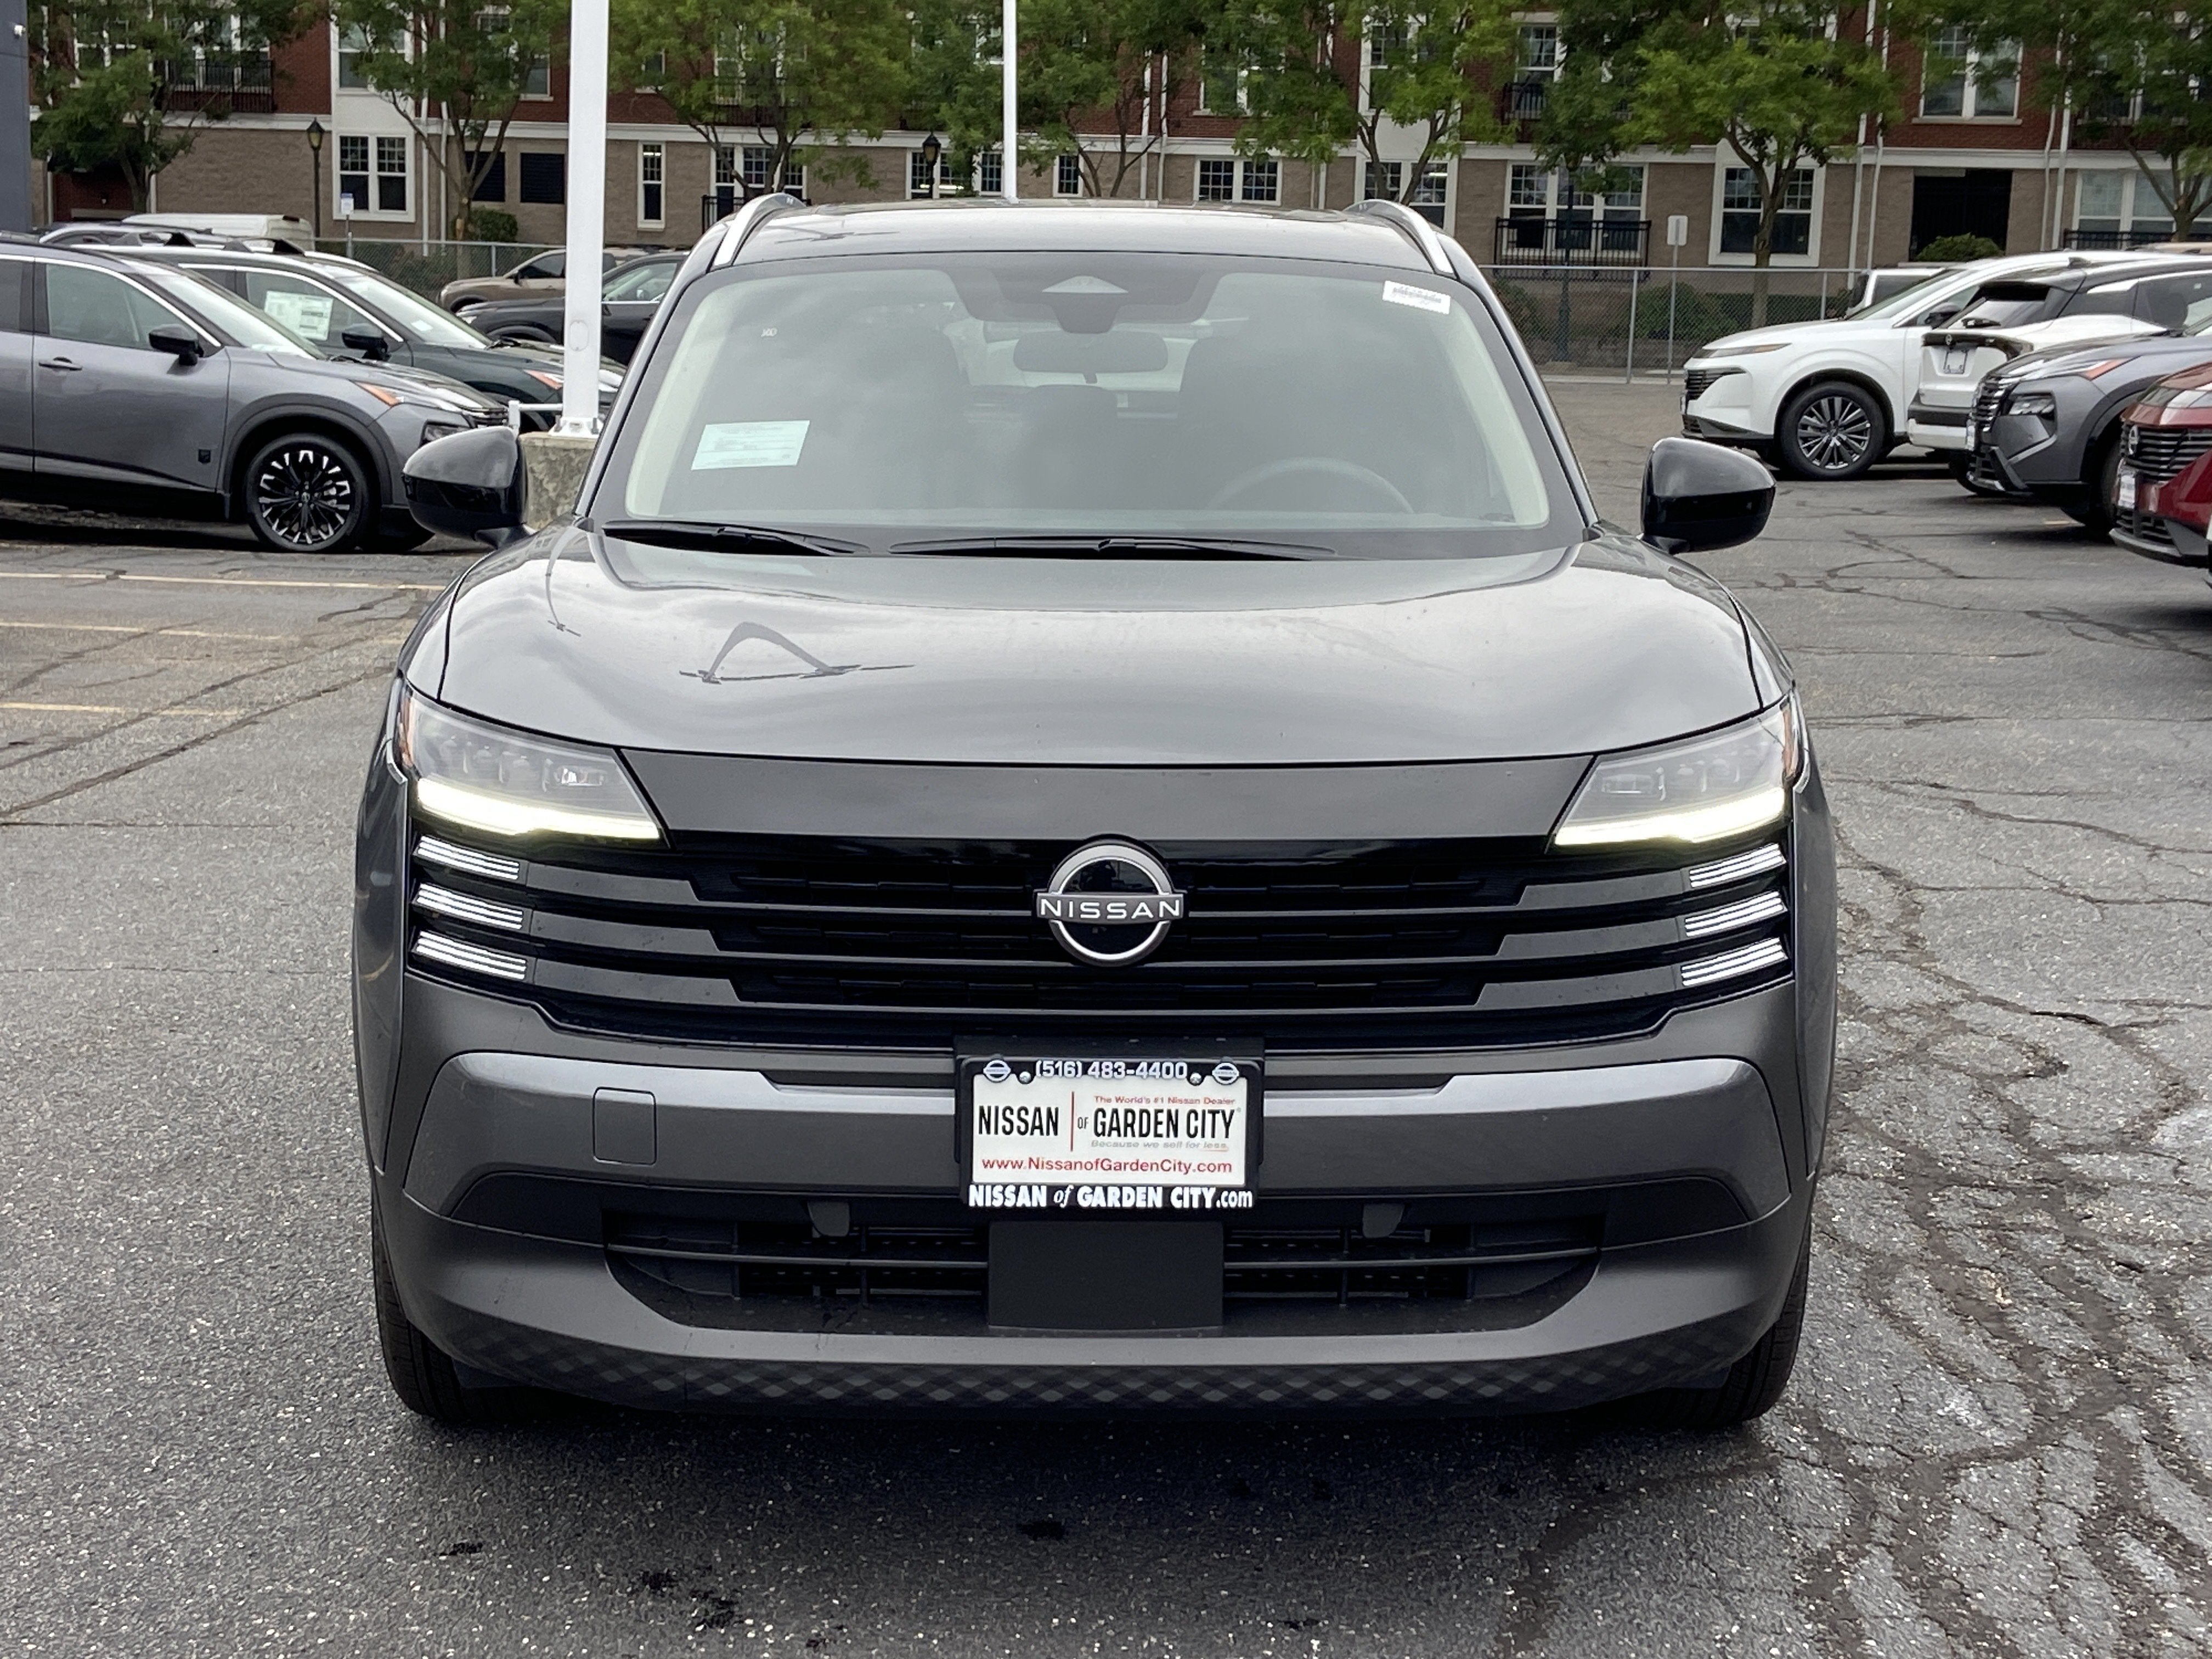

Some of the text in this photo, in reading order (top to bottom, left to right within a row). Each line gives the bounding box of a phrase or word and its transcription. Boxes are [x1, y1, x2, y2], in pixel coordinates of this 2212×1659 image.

[1040, 898, 1180, 919] NISSAN
[1035, 1059, 1187, 1079] (516) 483-4400
[1094, 1095, 1111, 1103] The
[978, 1105, 1235, 1139] NISSAN OF GARDEN CITY
[1091, 1140, 1139, 1148] Because
[1186, 1141, 1200, 1149] for
[981, 1157, 1232, 1175] www.NissanofGardenCity.com
[968, 1184, 1252, 1208] NISSAN of GARDEN CITY.com
